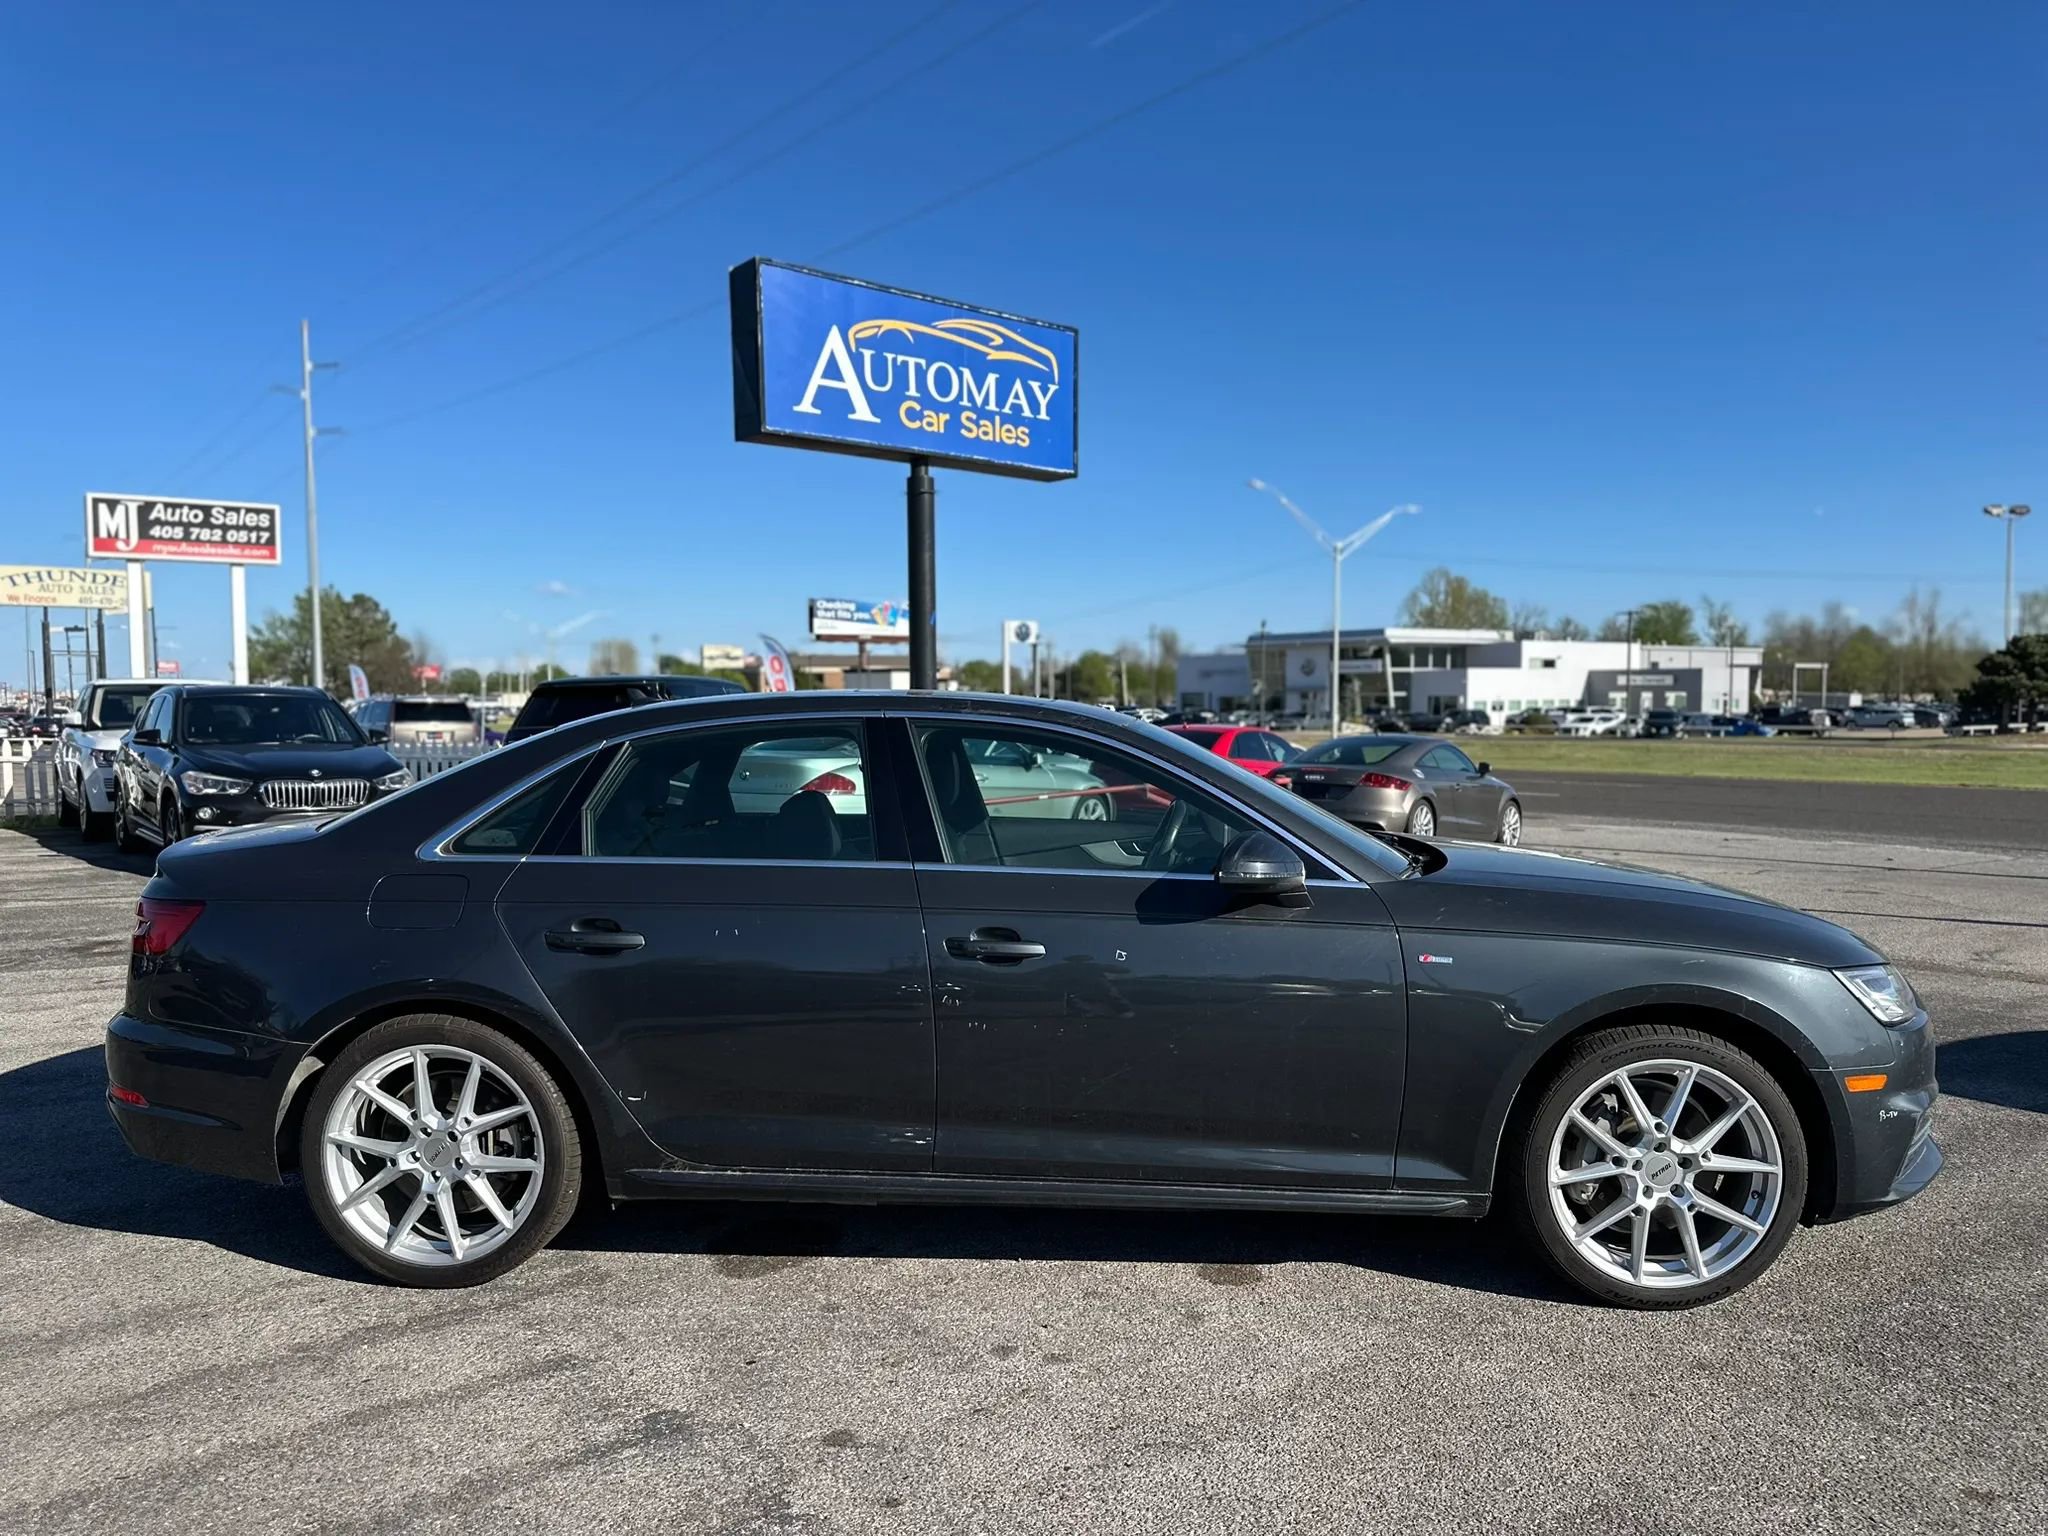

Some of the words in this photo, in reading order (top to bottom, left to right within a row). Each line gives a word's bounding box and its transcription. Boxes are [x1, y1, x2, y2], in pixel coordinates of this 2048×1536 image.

[792, 324, 1059, 423] AUTOMAY
[899, 400, 951, 434] Car
[960, 410, 1031, 448] Sales
[149, 503, 204, 523] Auto
[210, 507, 270, 527] Sales
[97, 500, 144, 552] MJ
[149, 525, 184, 539] 405
[190, 528, 222, 542] 782
[226, 530, 270, 544] 0517
[1, 570, 128, 588] THUNDE
[24, 594, 57, 603] Finance
[38, 583, 73, 594] AUTO
[80, 586, 115, 596] SALES
[1651, 1162, 1671, 1180] PETROL
